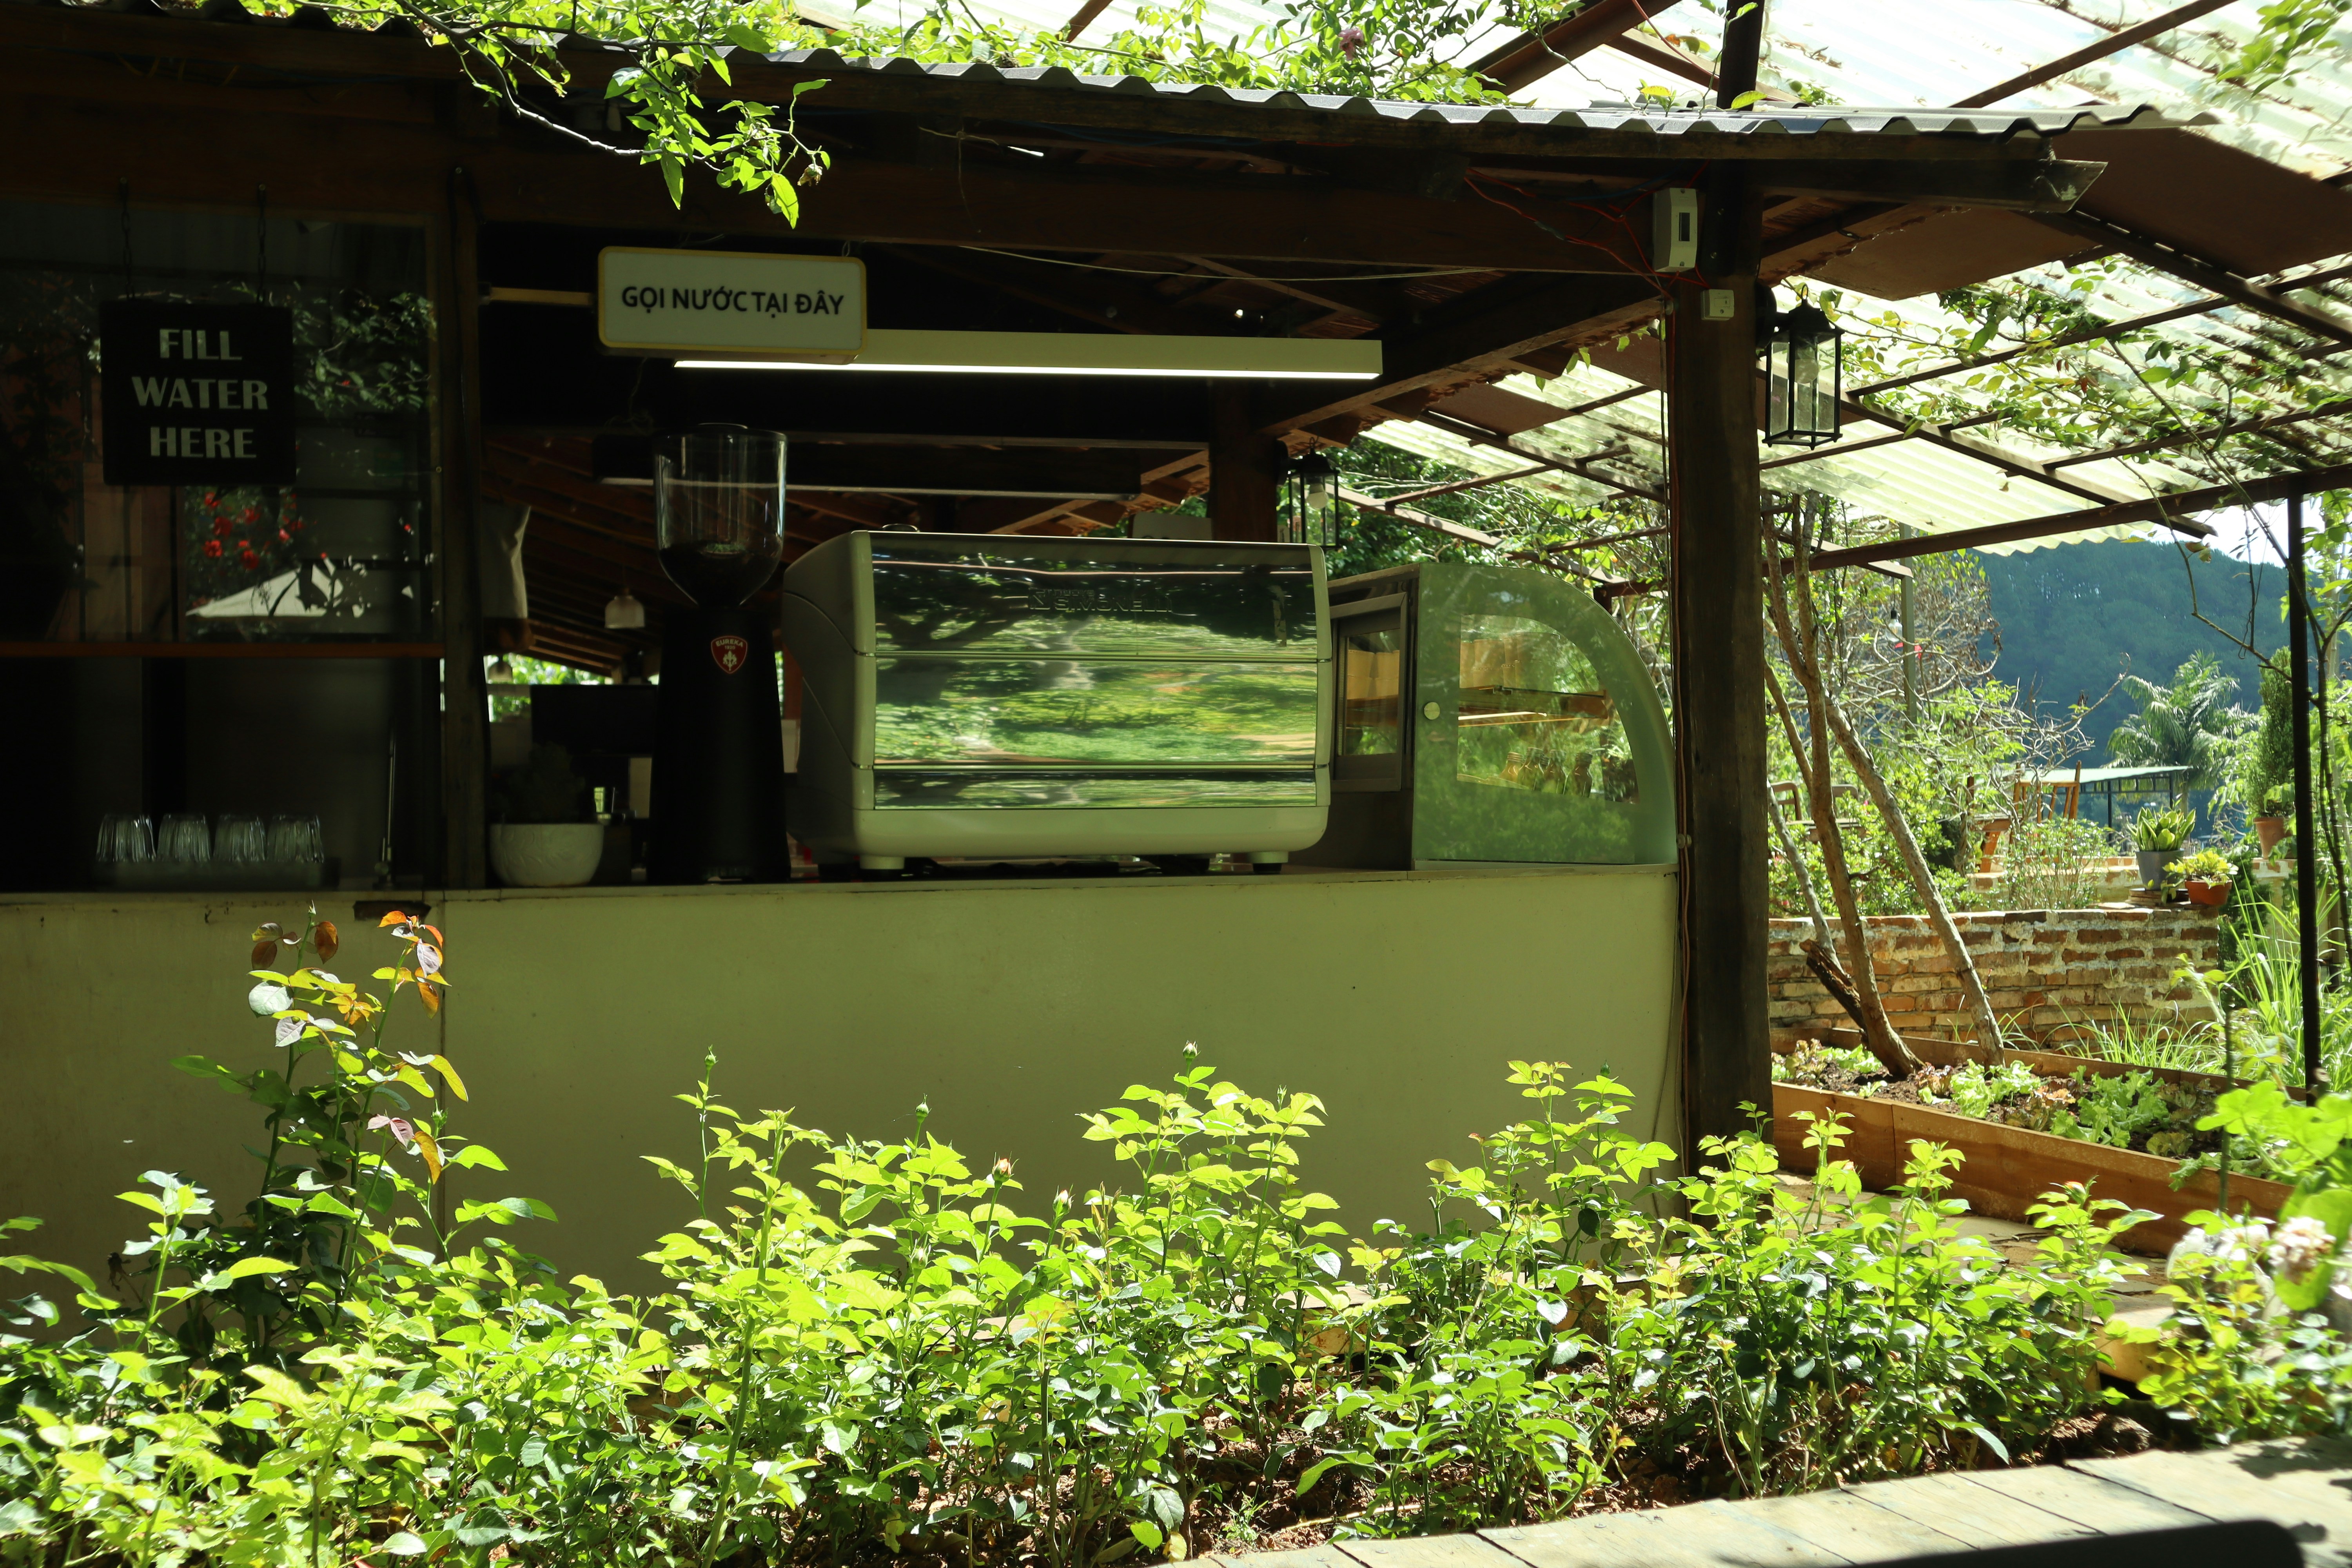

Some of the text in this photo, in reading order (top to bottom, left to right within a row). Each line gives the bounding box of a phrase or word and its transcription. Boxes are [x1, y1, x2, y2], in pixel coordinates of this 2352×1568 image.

[622, 286, 844, 318] GỌI NƯỚC TẠI ĐÂY
[159, 328, 243, 361] FILL
[131, 376, 269, 410] WATER
[150, 426, 257, 459] HERE
[716, 639, 743, 648] EUREKA
